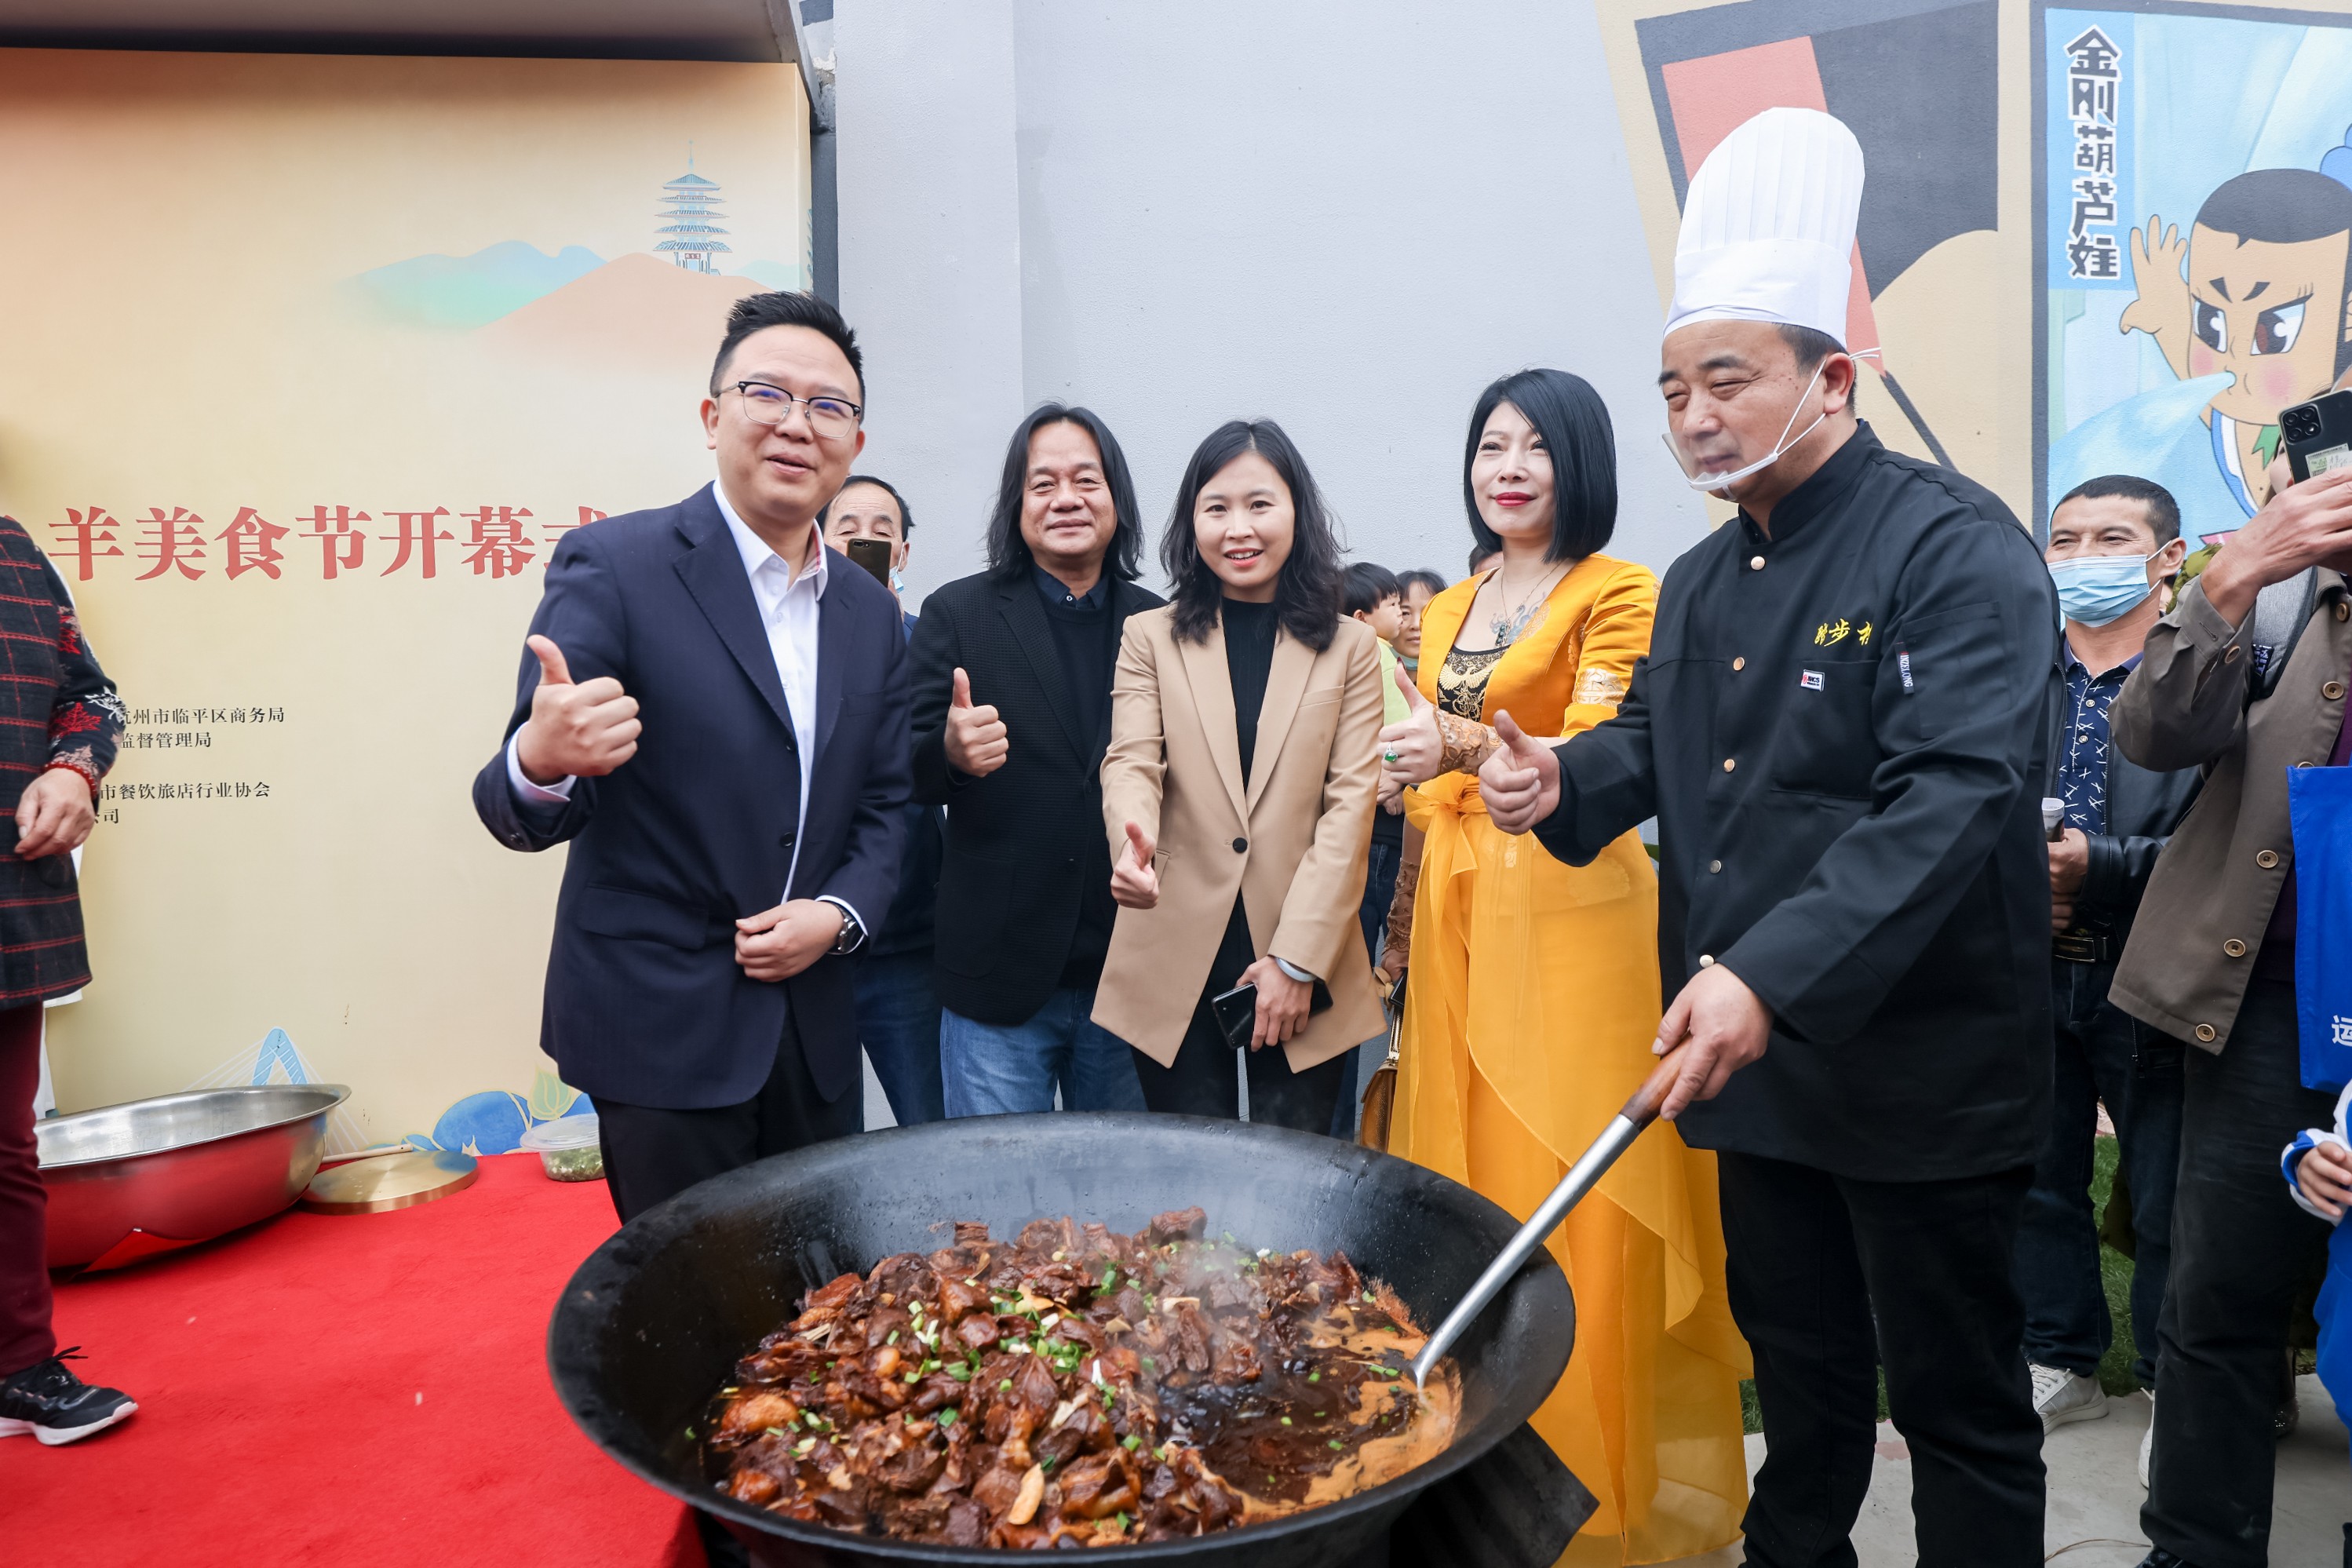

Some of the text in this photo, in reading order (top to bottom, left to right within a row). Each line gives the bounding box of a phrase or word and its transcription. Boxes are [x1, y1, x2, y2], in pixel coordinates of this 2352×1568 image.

[2065, 27, 2120, 278] 金刚葫芦娃
[4, 505, 608, 581] 羊美食节开幕
[120, 731, 212, 749] 监督管理局
[100, 782, 271, 800] 市餐饮旅店行业协会
[94, 808, 119, 825] 司
